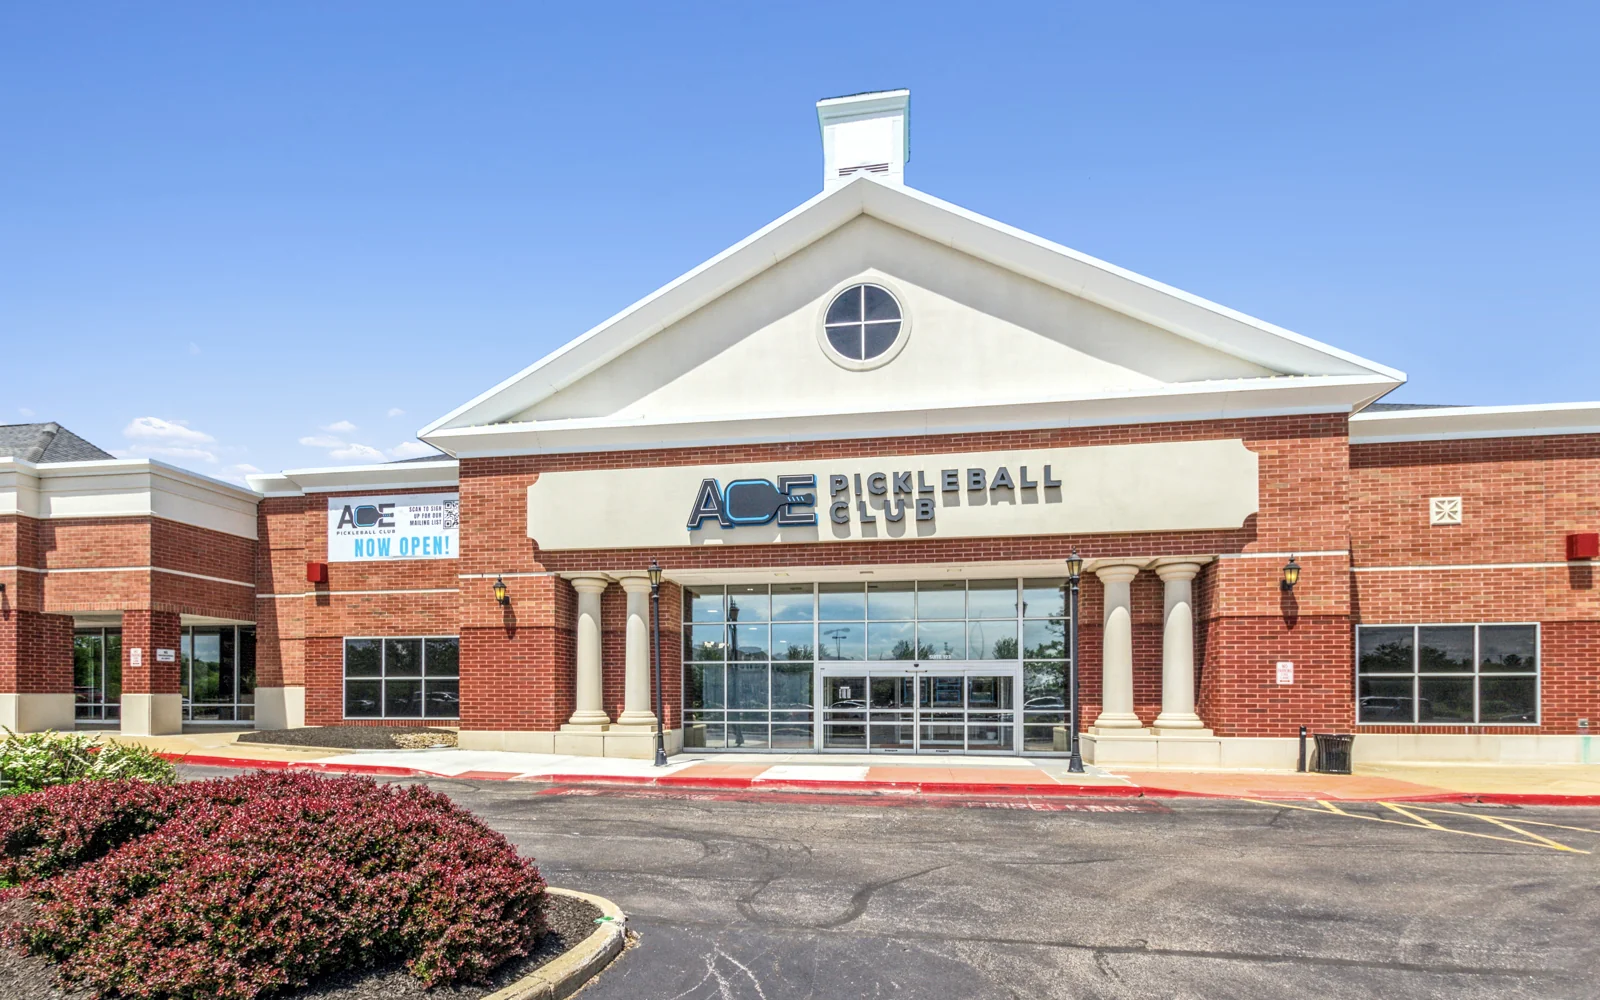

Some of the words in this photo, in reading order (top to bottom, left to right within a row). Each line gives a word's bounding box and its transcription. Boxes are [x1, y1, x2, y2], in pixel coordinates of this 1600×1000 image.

[829, 464, 1062, 497] PICKLEBALL
[829, 498, 935, 524] CLUB
[355, 538, 391, 557] NOW
[400, 536, 450, 556] OPEN!
